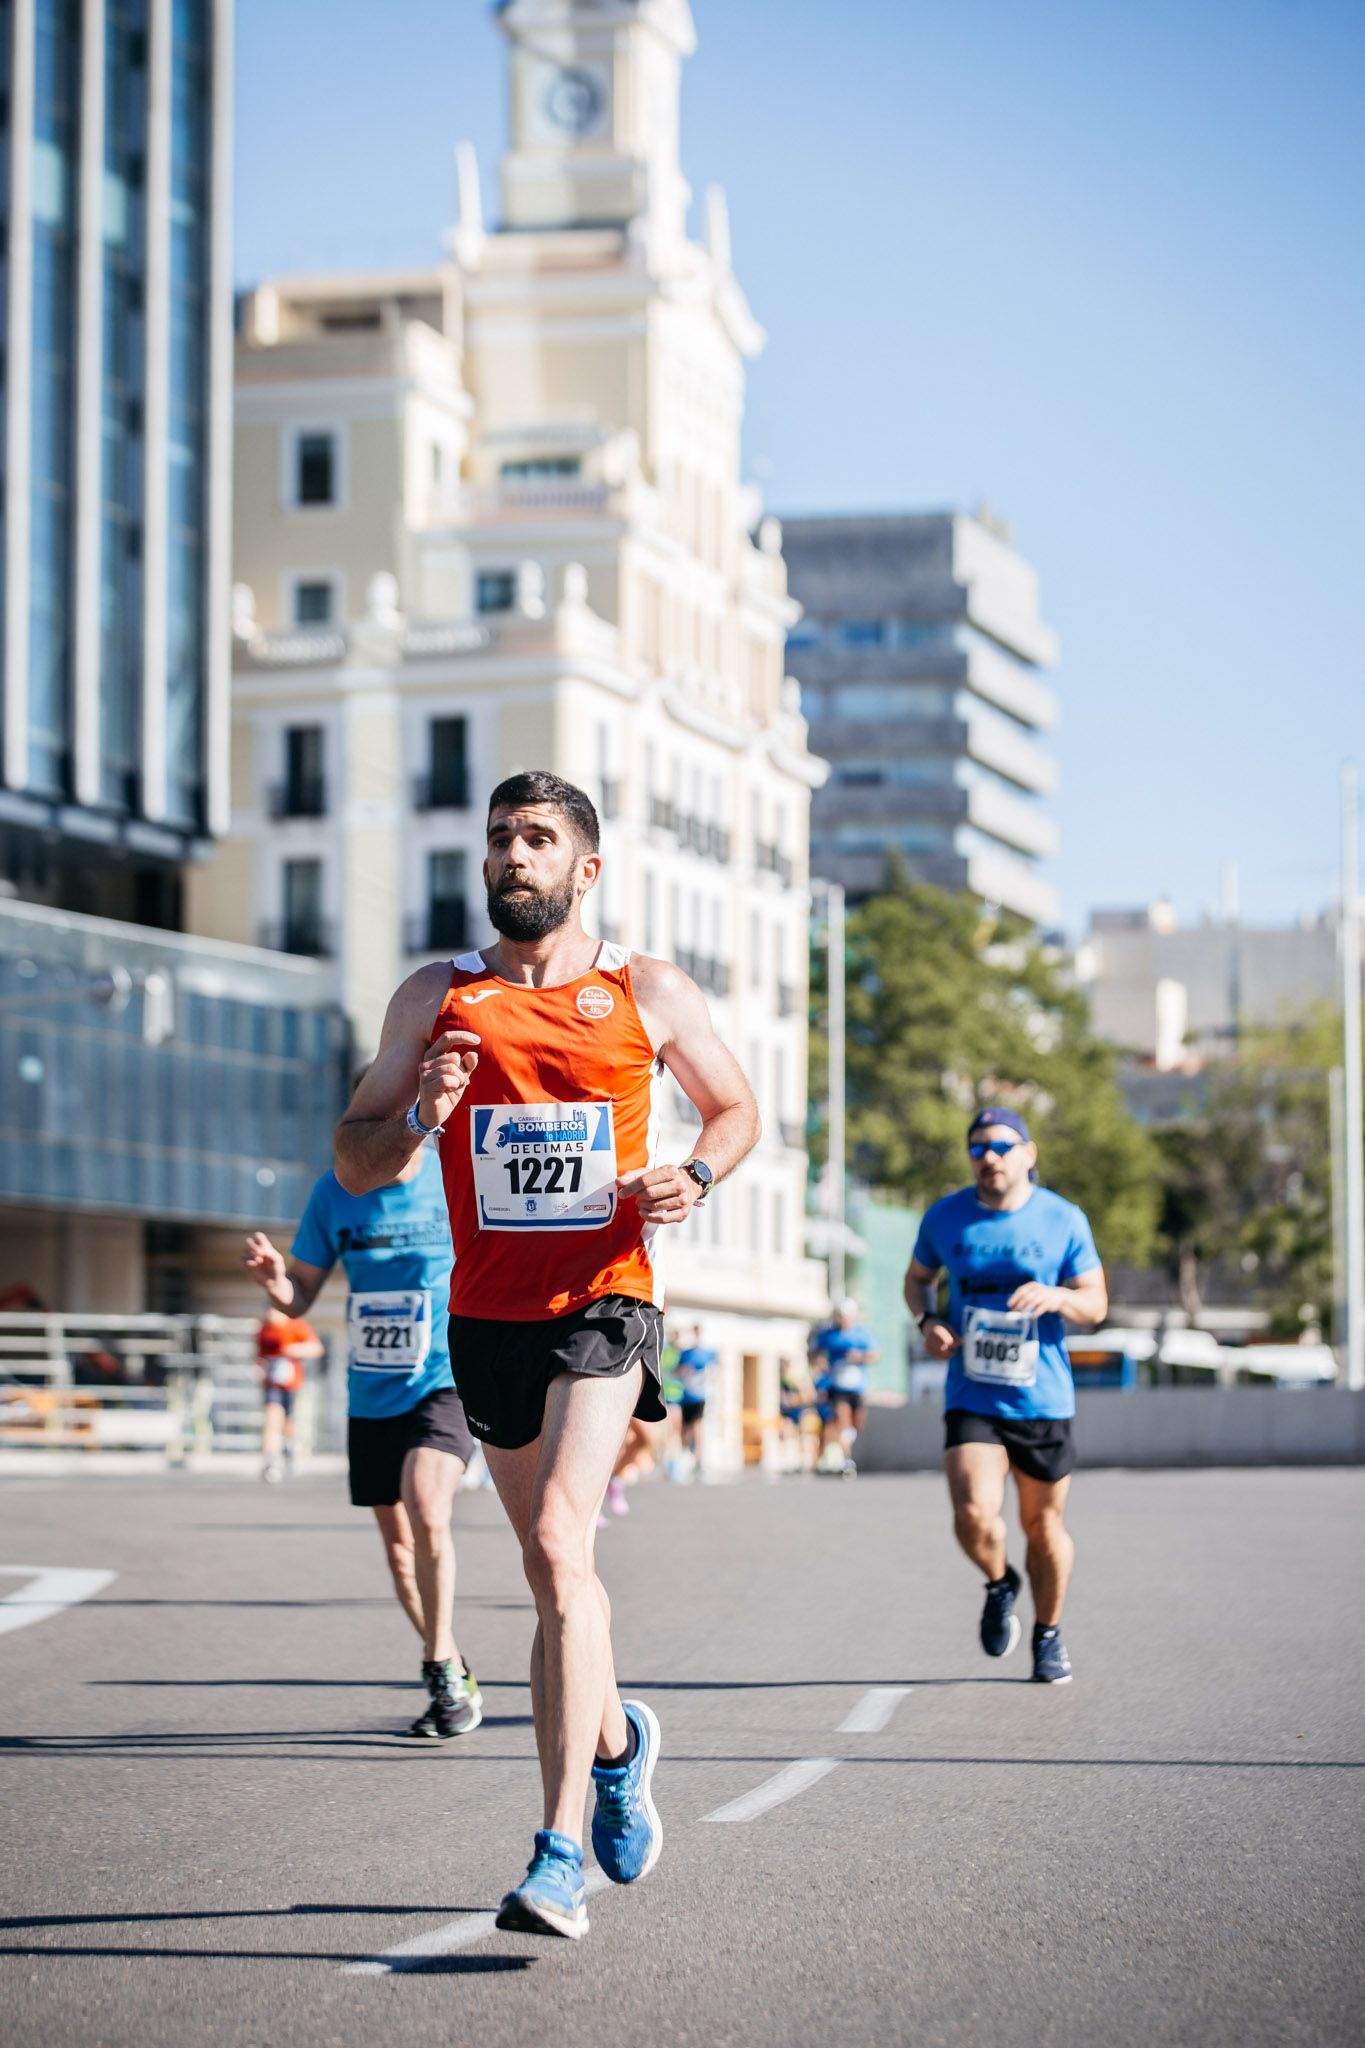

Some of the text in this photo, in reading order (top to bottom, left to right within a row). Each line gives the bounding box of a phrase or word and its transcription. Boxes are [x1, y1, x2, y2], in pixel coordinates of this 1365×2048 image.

[518, 1121, 585, 1132] BOMBEROS
[555, 1130, 586, 1141] MADRID
[511, 1142, 584, 1154] DECIMAS
[503, 1156, 583, 1195] 1227
[362, 1326, 412, 1349] 2221
[975, 1339, 1020, 1362] 1003
